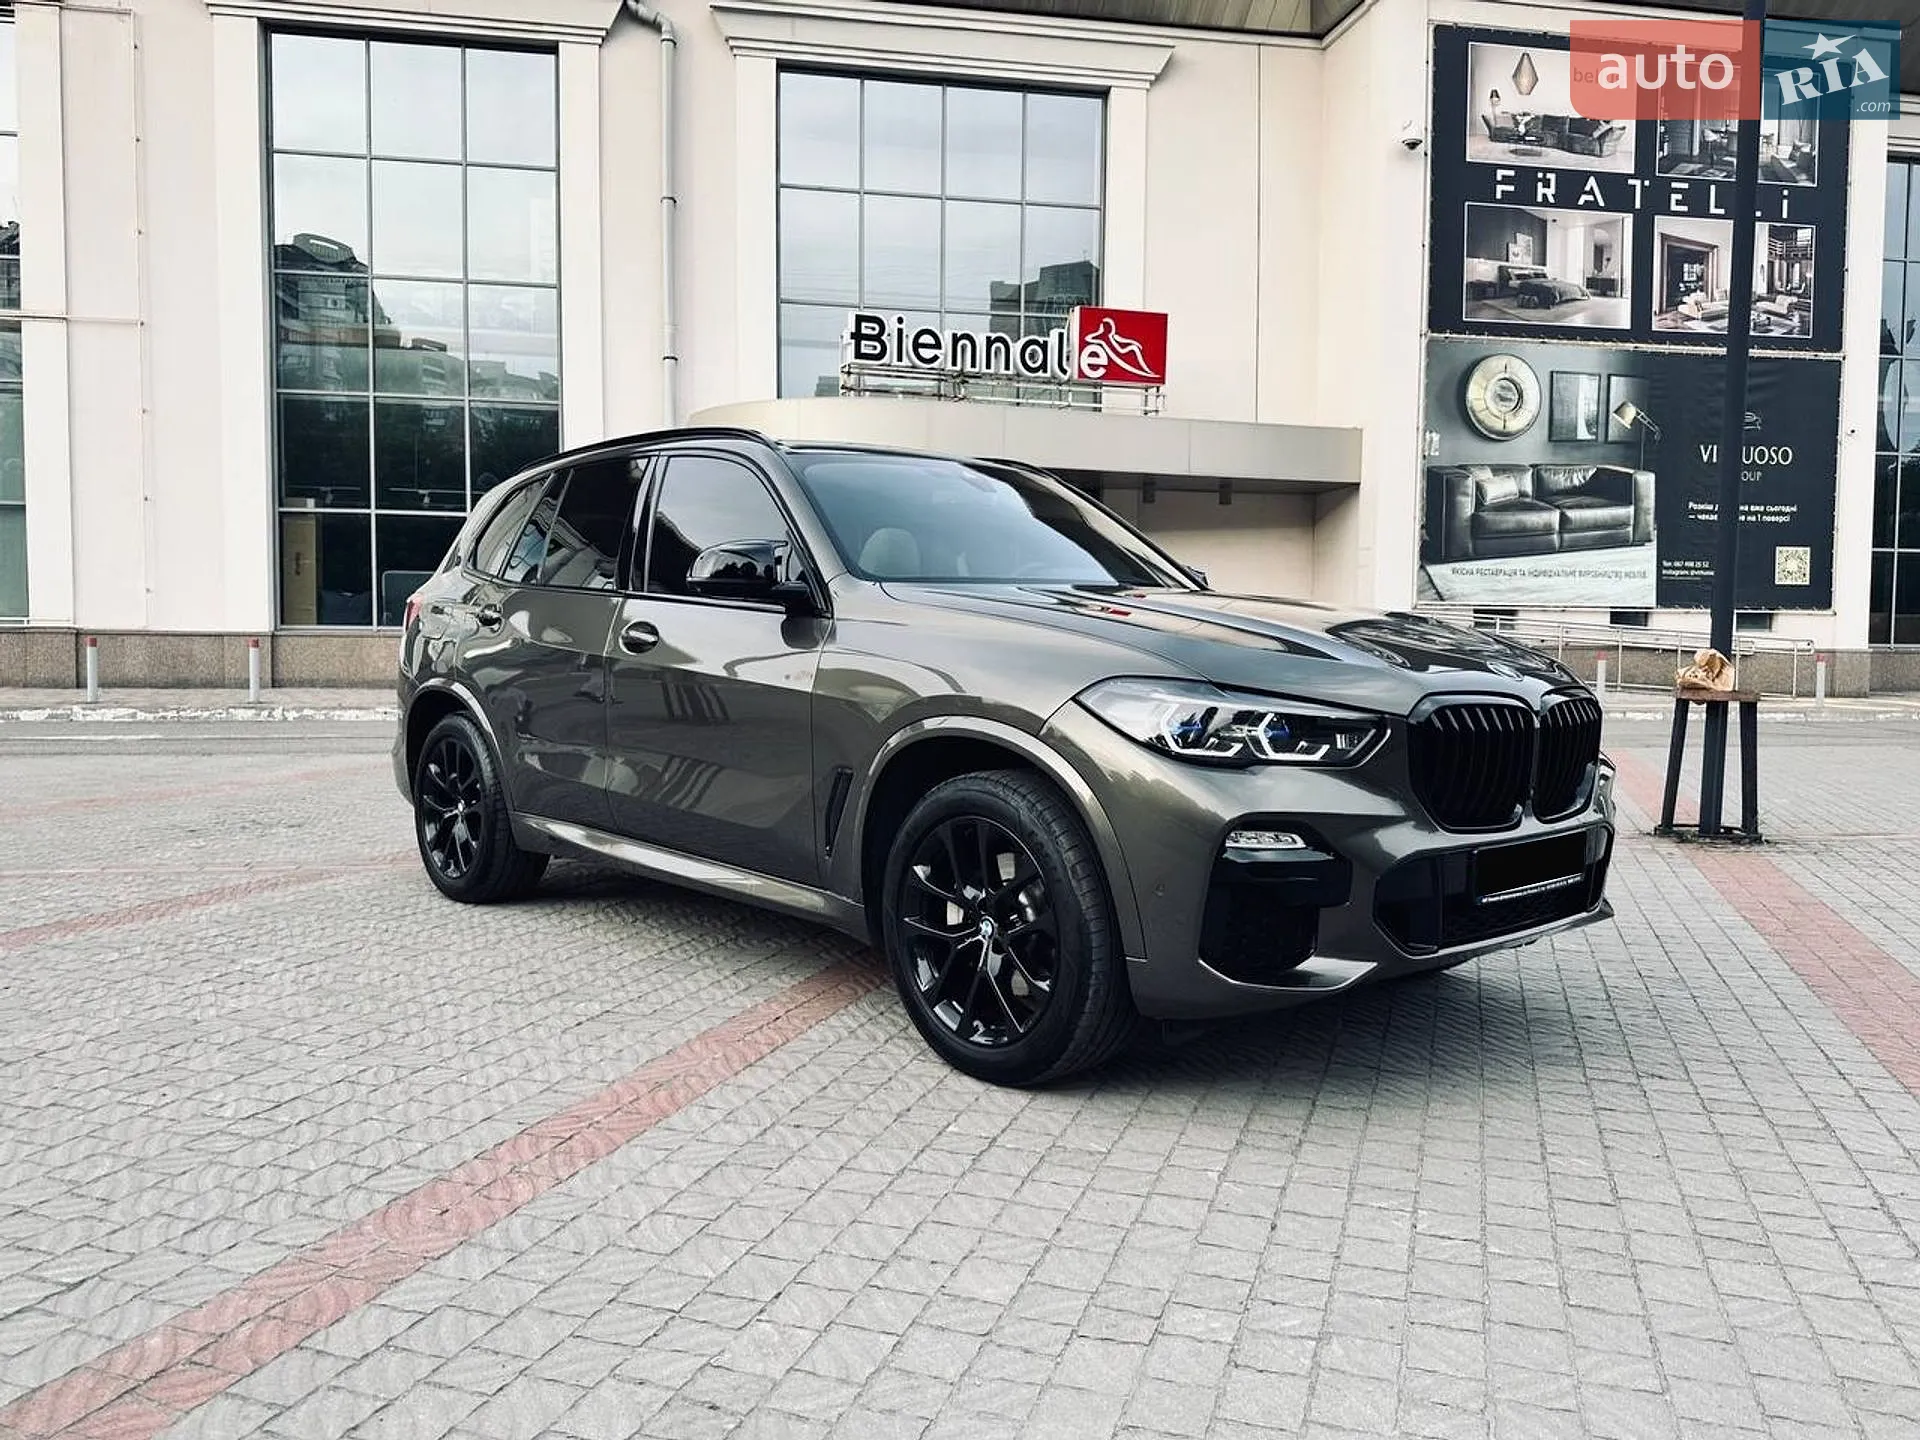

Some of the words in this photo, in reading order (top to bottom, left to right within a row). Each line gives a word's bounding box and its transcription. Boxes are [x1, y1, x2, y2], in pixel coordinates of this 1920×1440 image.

[1495, 169, 1789, 219] FRATELI
[849, 312, 1109, 379] Biennale
[1699, 444, 1793, 465] VIUOSO
